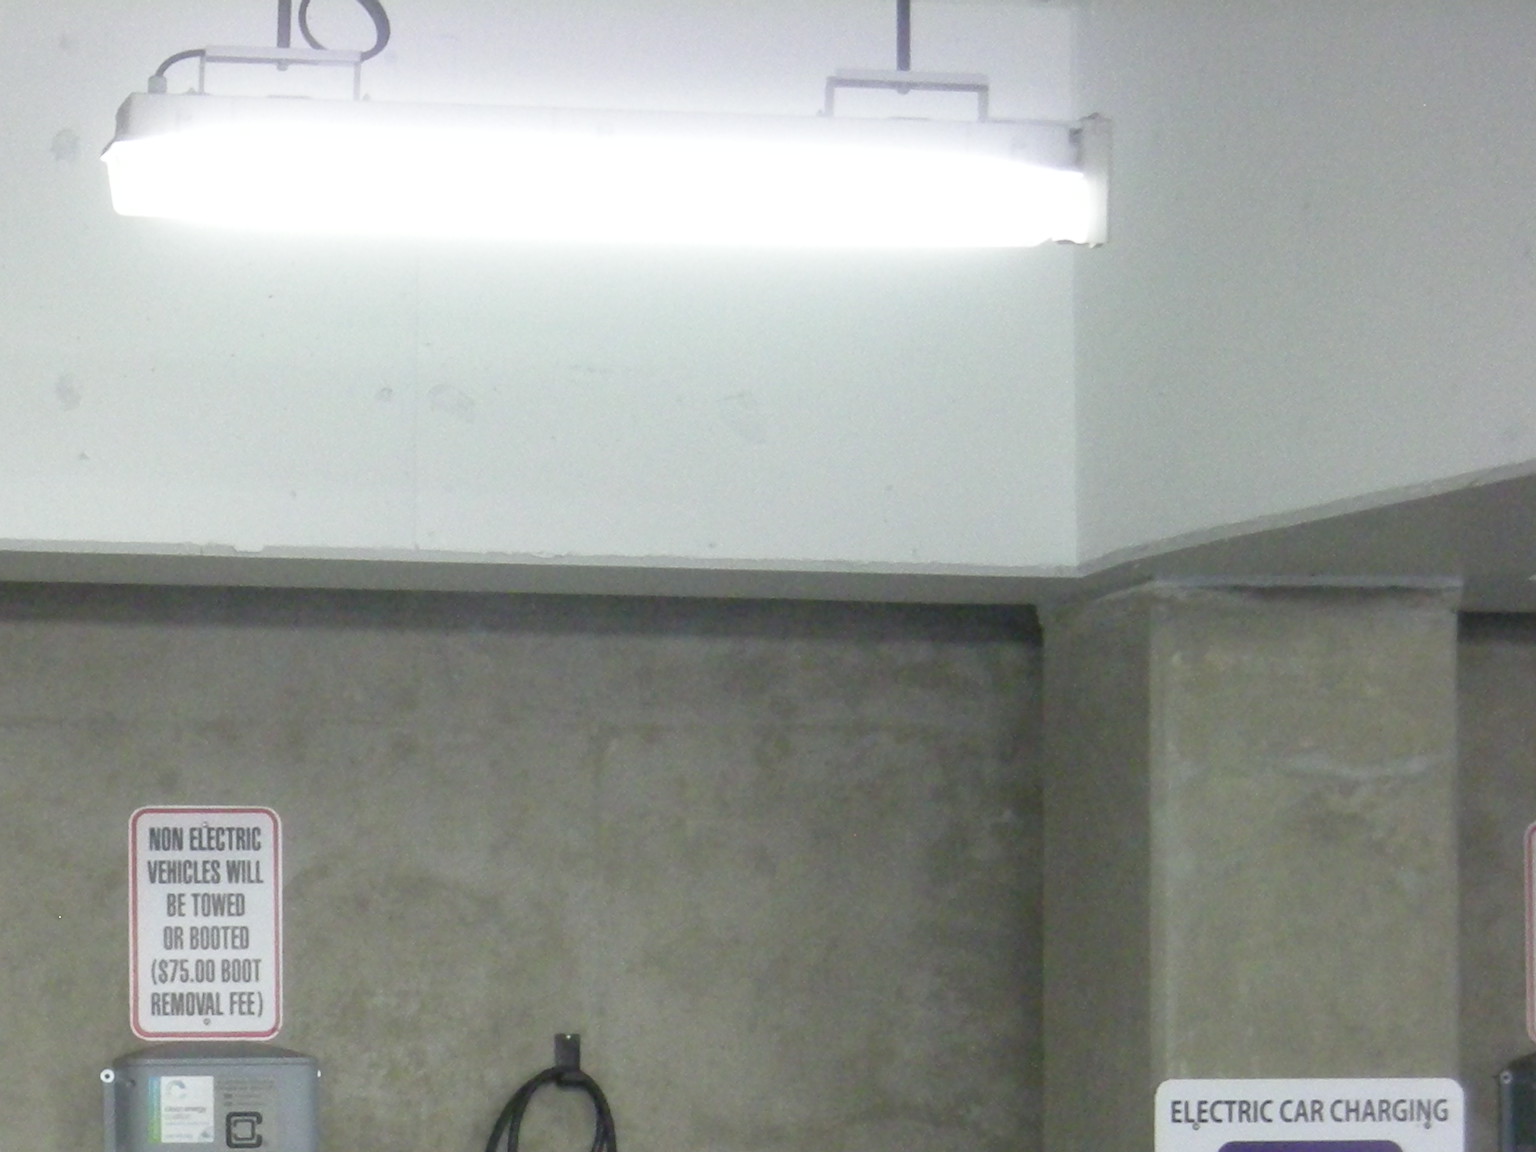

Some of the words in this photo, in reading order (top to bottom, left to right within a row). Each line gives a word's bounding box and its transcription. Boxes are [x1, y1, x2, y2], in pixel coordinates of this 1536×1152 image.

[149, 827, 184, 851] NON
[189, 827, 262, 851] ELECTRIC
[147, 860, 221, 884] VEHICLES
[226, 860, 264, 884] WILL
[166, 893, 185, 917] BE
[191, 893, 245, 917] TOWED
[163, 926, 184, 950] OR
[189, 926, 250, 950] BOOTED
[151, 959, 215, 985] ($75.00
[221, 959, 262, 983] BOOT
[151, 992, 224, 1016] REMOVAL
[229, 991, 263, 1018] FEE)
[1170, 1099, 1274, 1124] ELECTRIC
[1279, 1099, 1324, 1123] CAR
[1329, 1098, 1450, 1123] CHARGING
